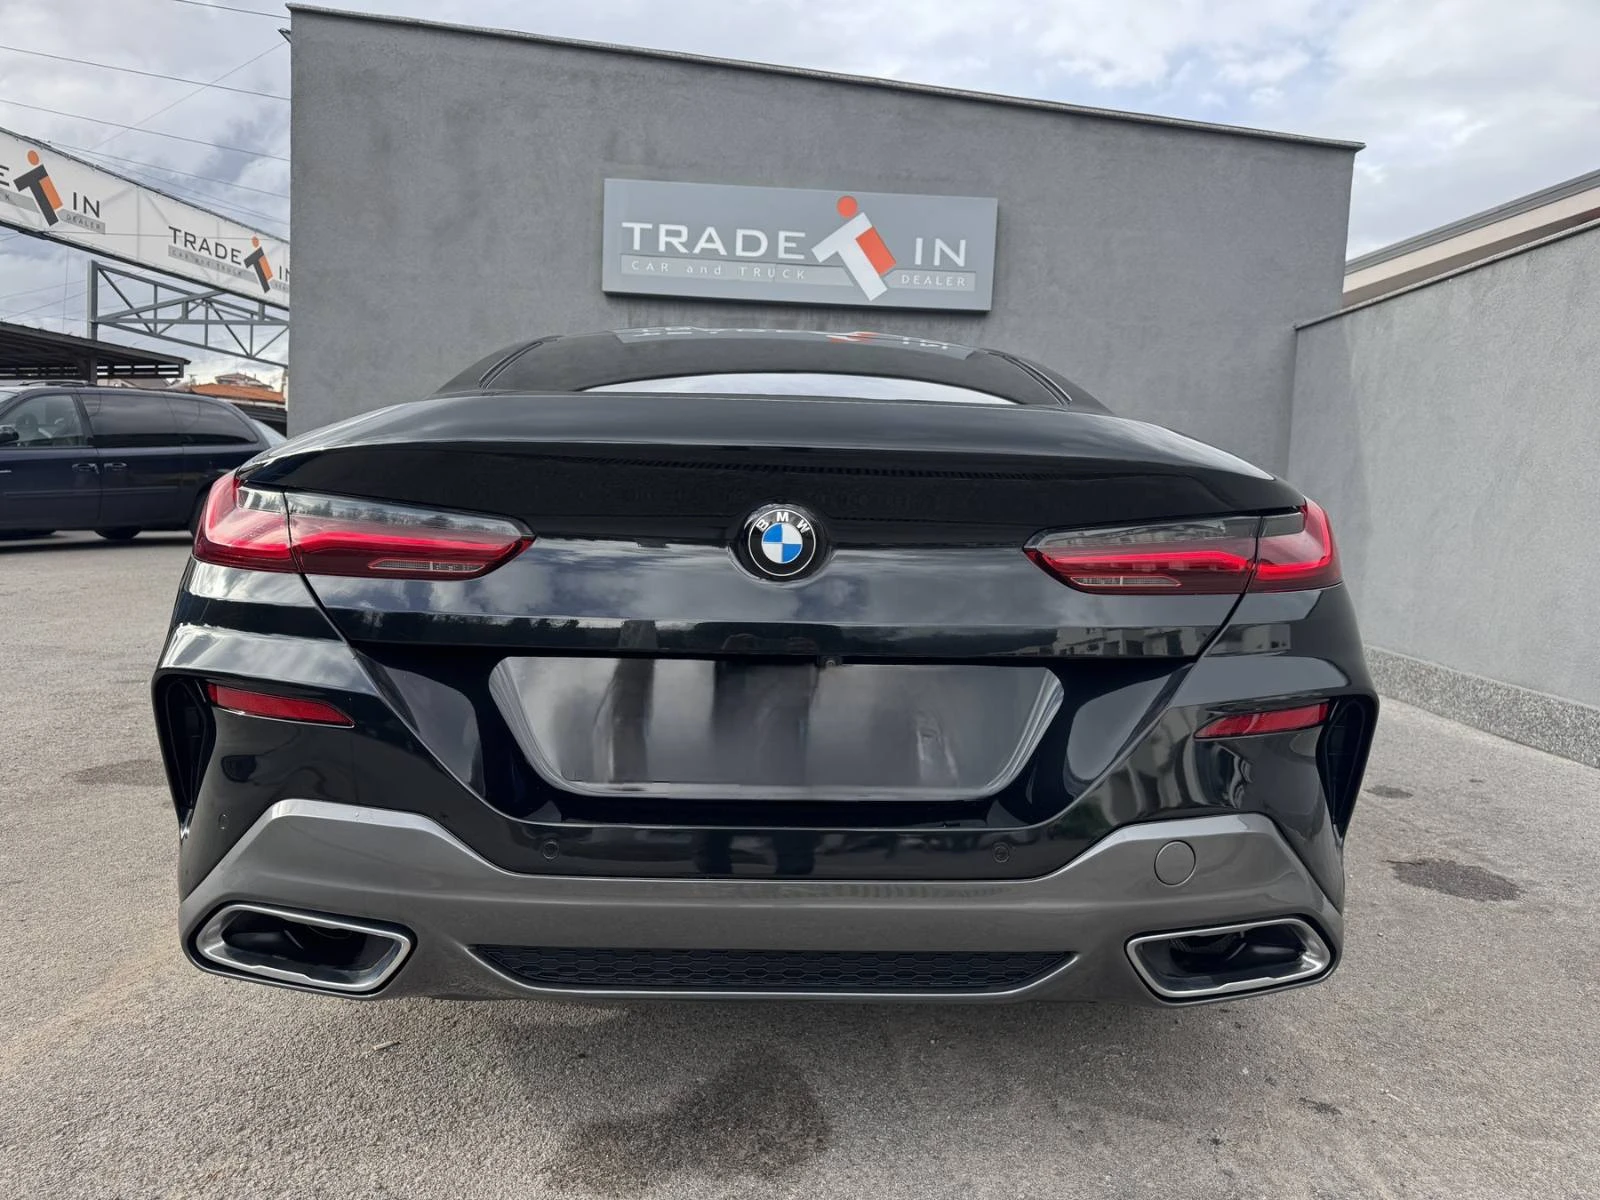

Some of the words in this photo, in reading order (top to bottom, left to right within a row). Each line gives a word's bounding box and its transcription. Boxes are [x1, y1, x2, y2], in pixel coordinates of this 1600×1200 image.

[73, 192, 100, 218] IN
[168, 226, 242, 266] TRADE
[622, 222, 806, 260] TRADE
[914, 237, 967, 267] IN
[631, 260, 669, 272] CAR
[686, 264, 722, 276] and
[740, 266, 805, 279] TRUCK
[901, 274, 966, 287] DEALER
[755, 511, 811, 534] BMW
